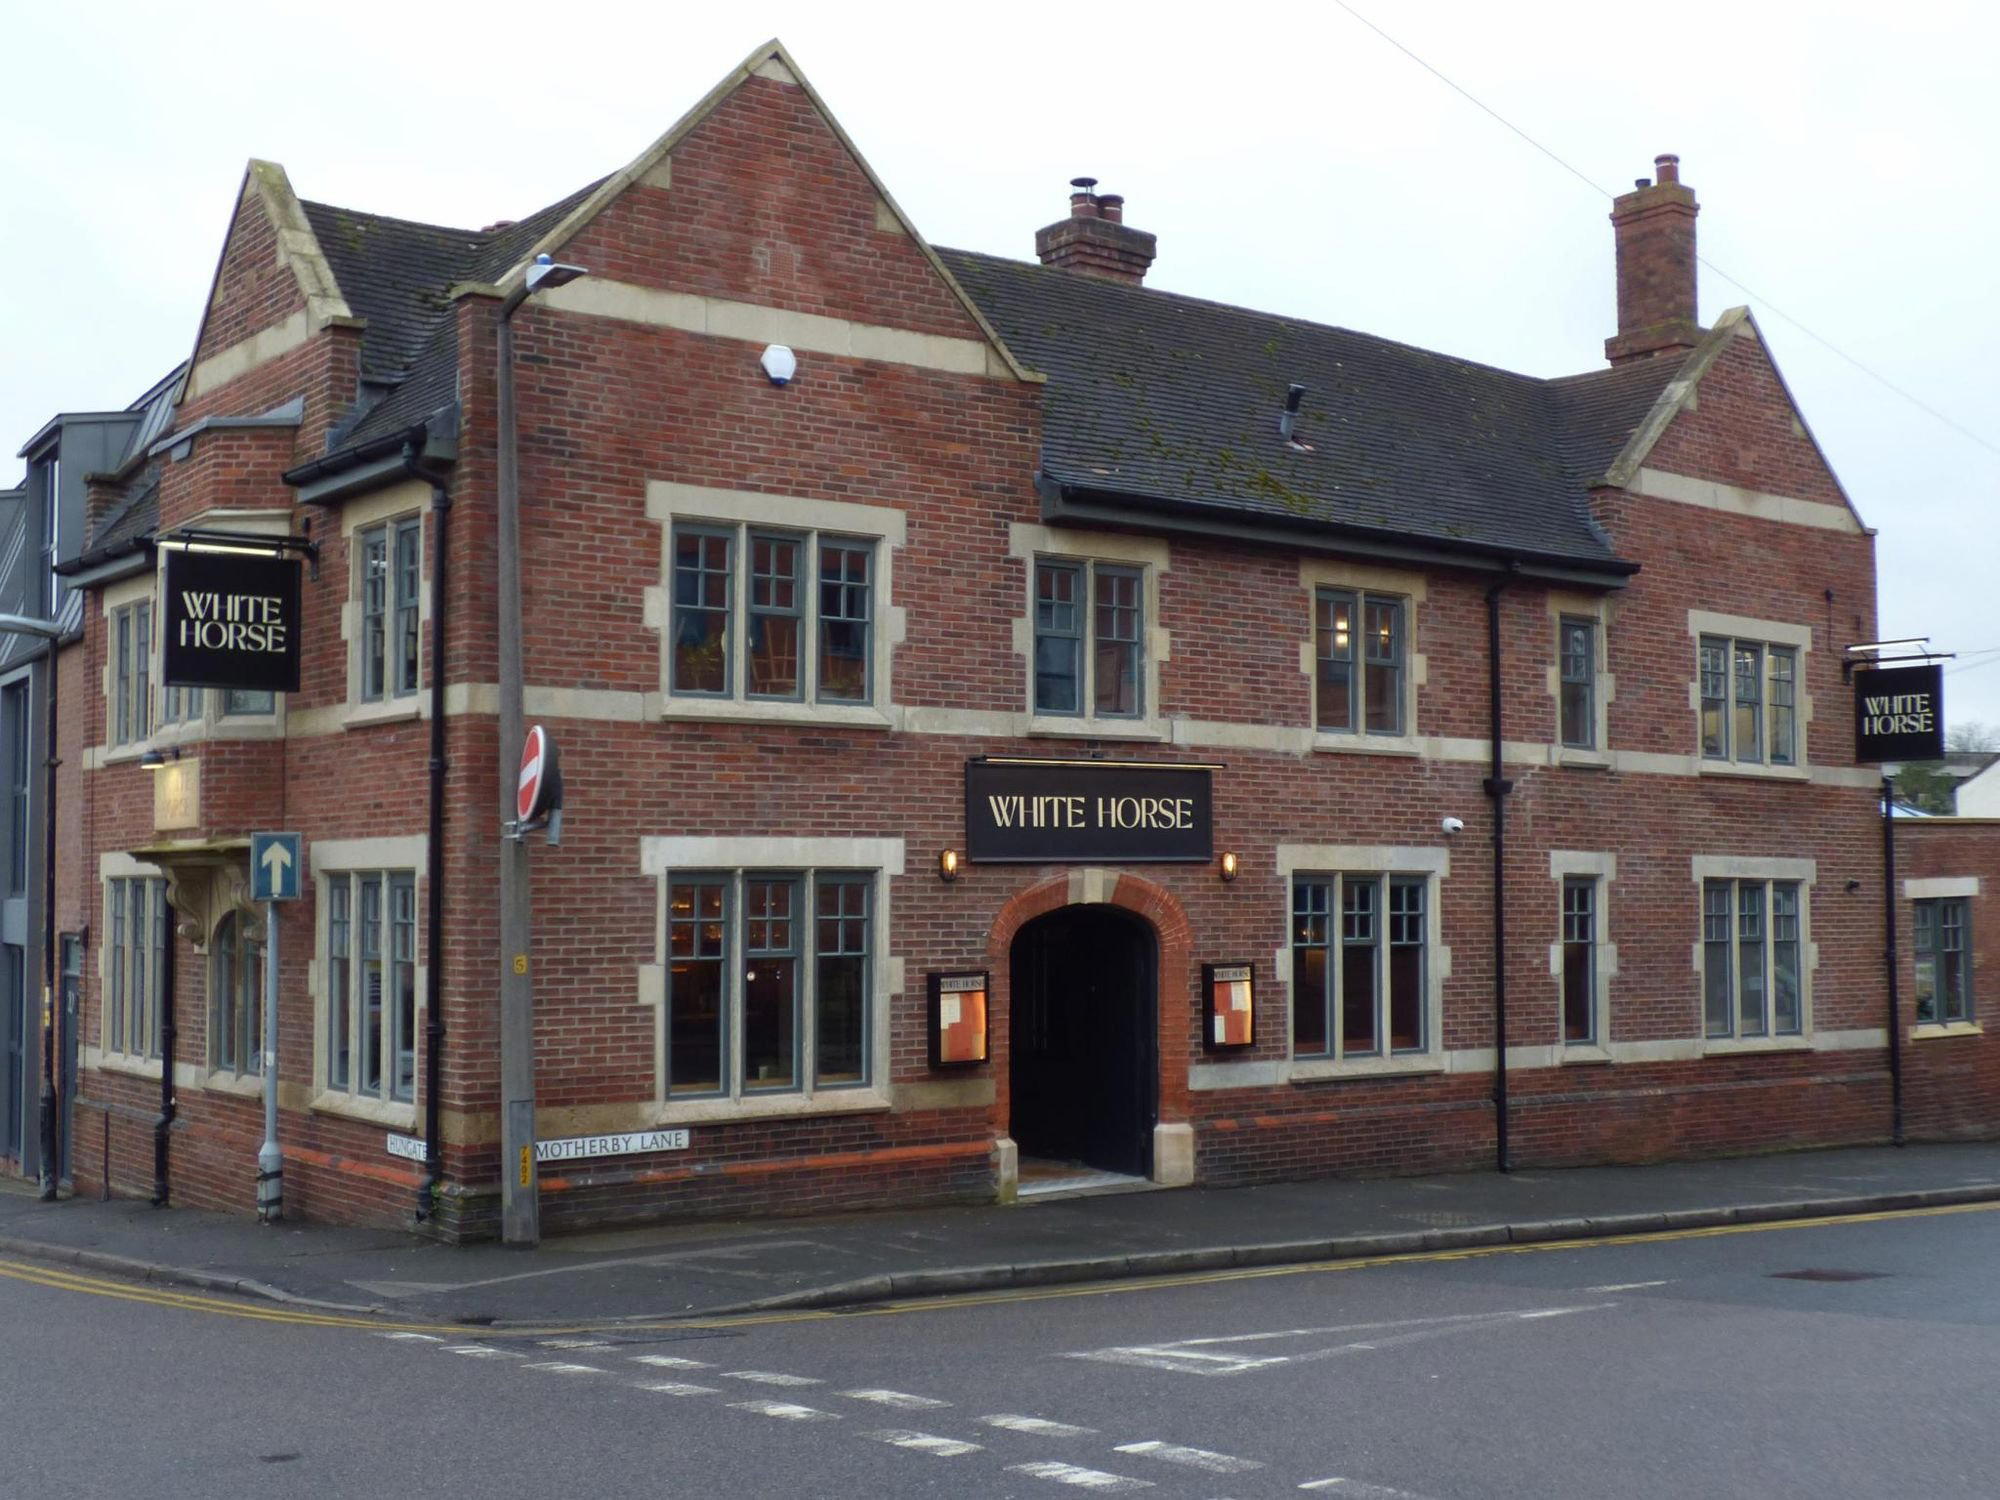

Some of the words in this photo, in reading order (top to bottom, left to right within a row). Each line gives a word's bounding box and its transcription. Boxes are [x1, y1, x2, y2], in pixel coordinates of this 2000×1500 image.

[182, 590, 282, 624] WHITE
[180, 619, 286, 653] HORSE
[1865, 694, 1930, 715] WHITE
[1864, 713, 1934, 735] HORSE
[988, 795, 1086, 828] WHITE
[1097, 797, 1194, 829] HORSE
[389, 1135, 427, 1159] HUNGATE
[536, 1136, 631, 1159] MOTHERBY
[641, 1132, 682, 1150] LANE
